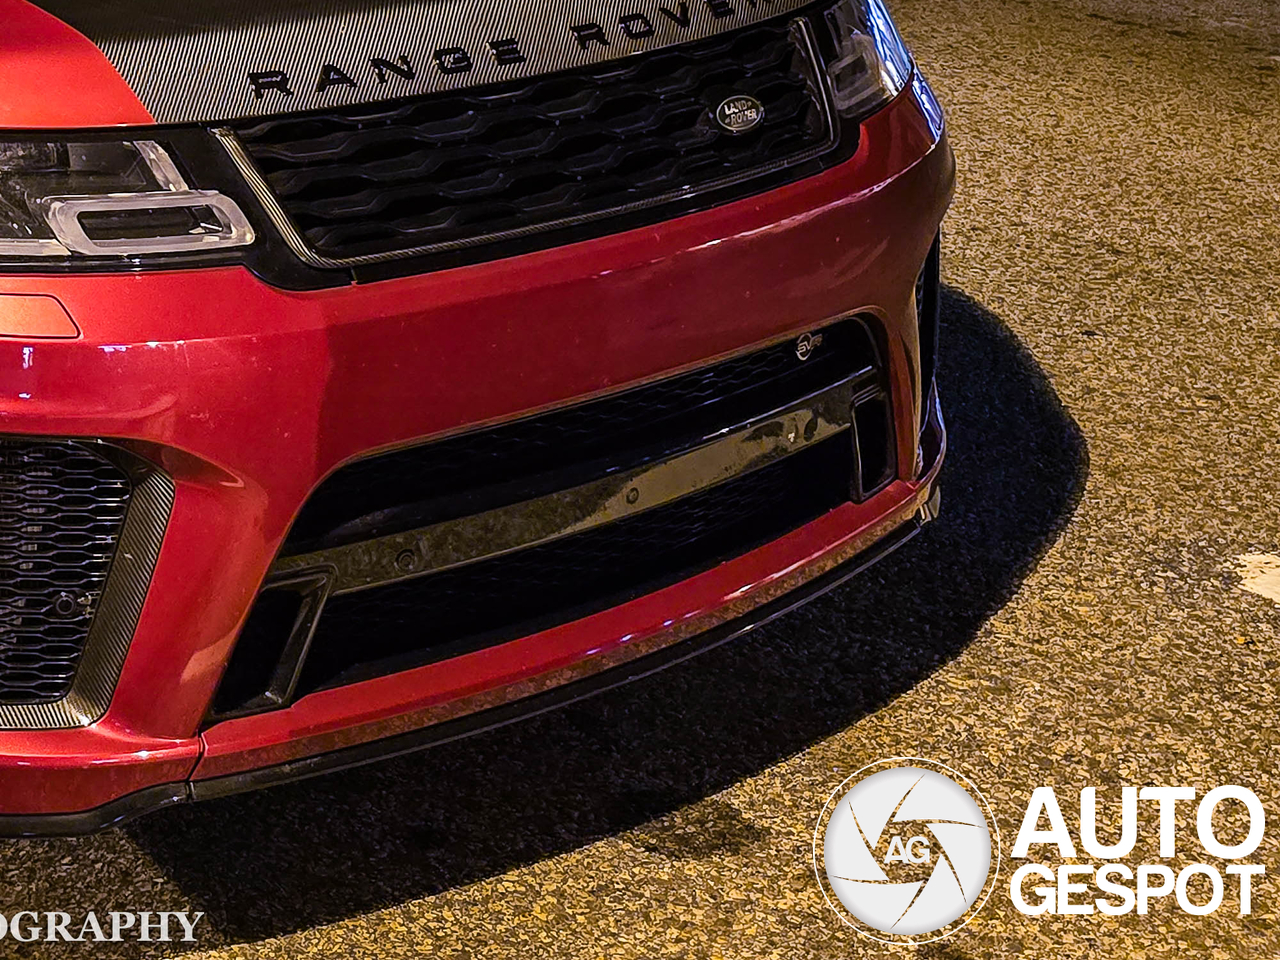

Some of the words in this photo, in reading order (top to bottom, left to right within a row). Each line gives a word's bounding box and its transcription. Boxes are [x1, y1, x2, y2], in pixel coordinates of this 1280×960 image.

[246, 36, 526, 101] RANGE
[724, 100, 747, 115] LAND
[730, 108, 758, 125] ROVER
